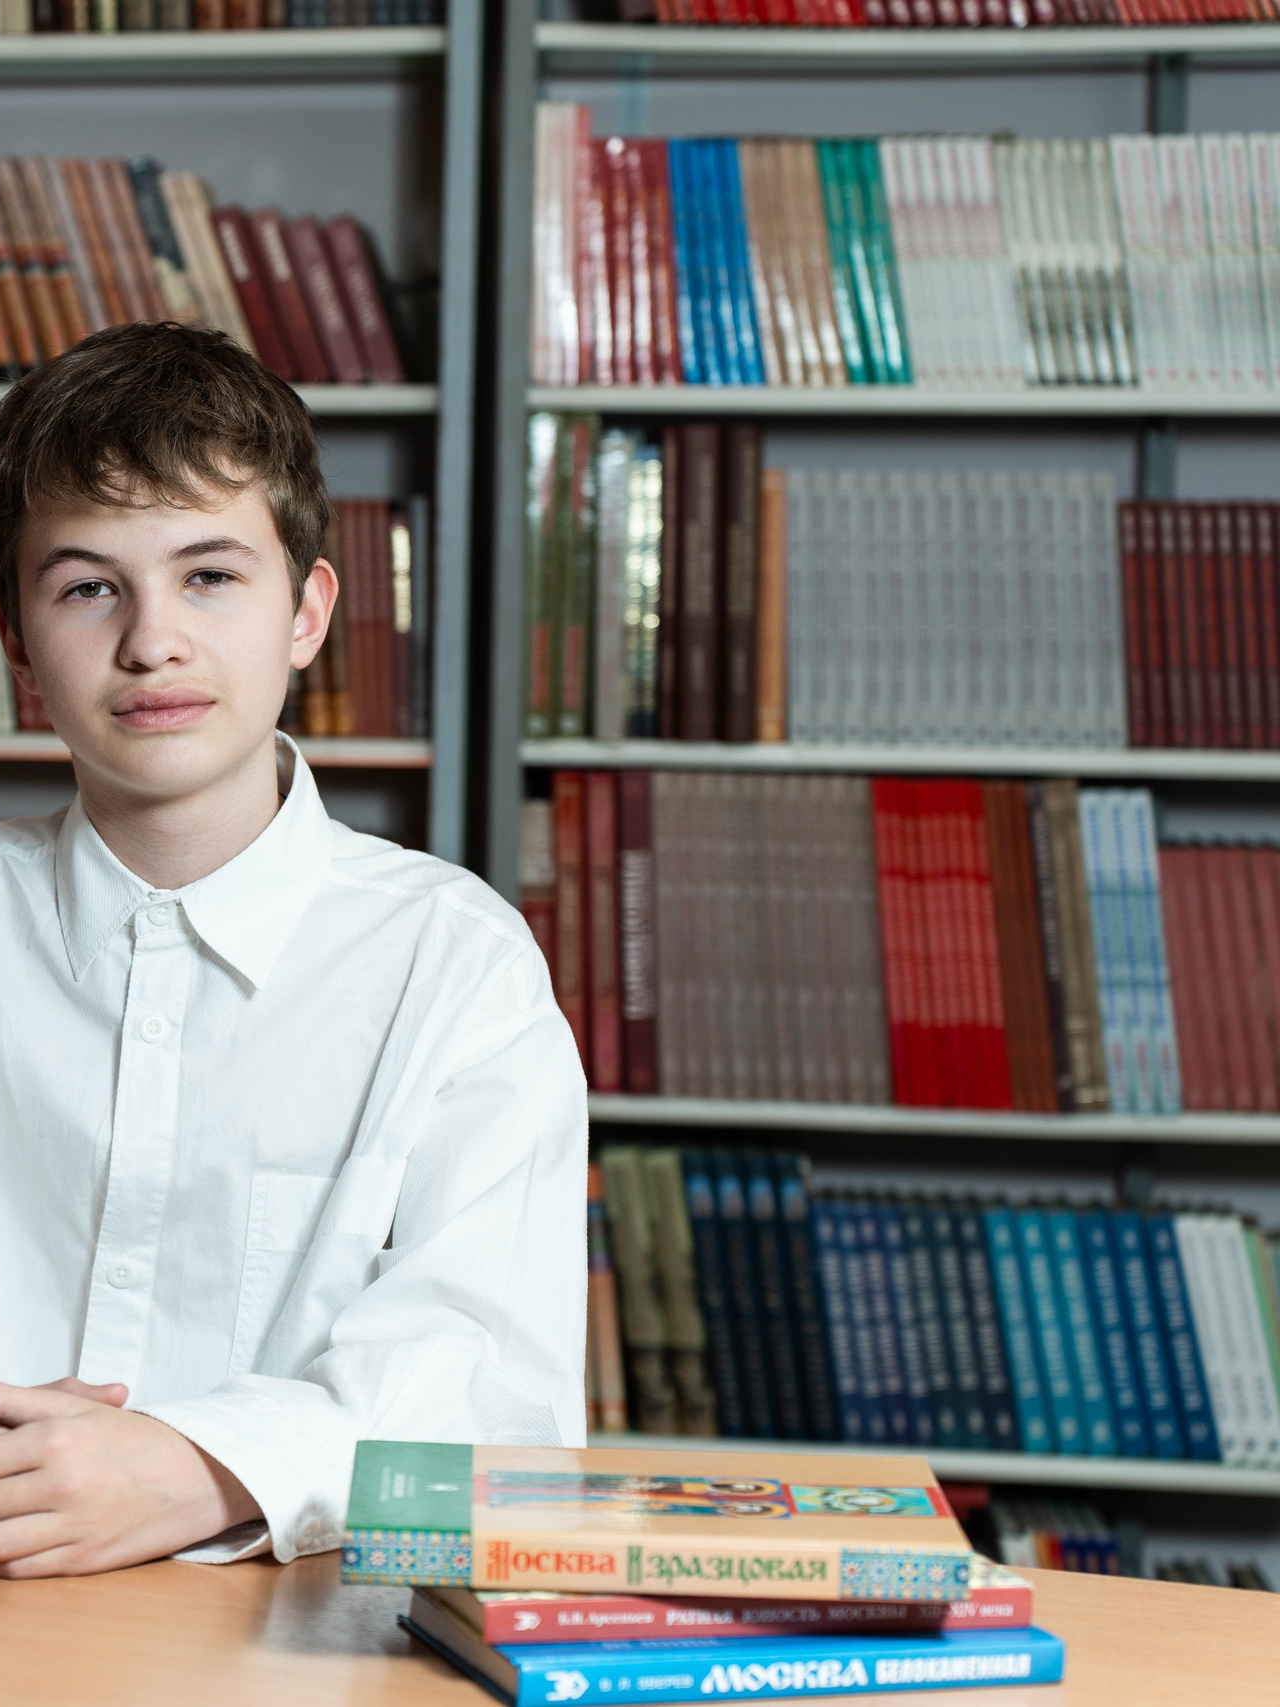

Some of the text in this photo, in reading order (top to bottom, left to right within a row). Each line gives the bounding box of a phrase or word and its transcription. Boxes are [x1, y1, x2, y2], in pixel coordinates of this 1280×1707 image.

[486, 1541, 617, 1582] Москва
[742, 1607, 820, 1624] ЮНОСТЬ
[828, 1604, 907, 1620] МОСКВЫ
[701, 1658, 869, 1694] МОСКВА
